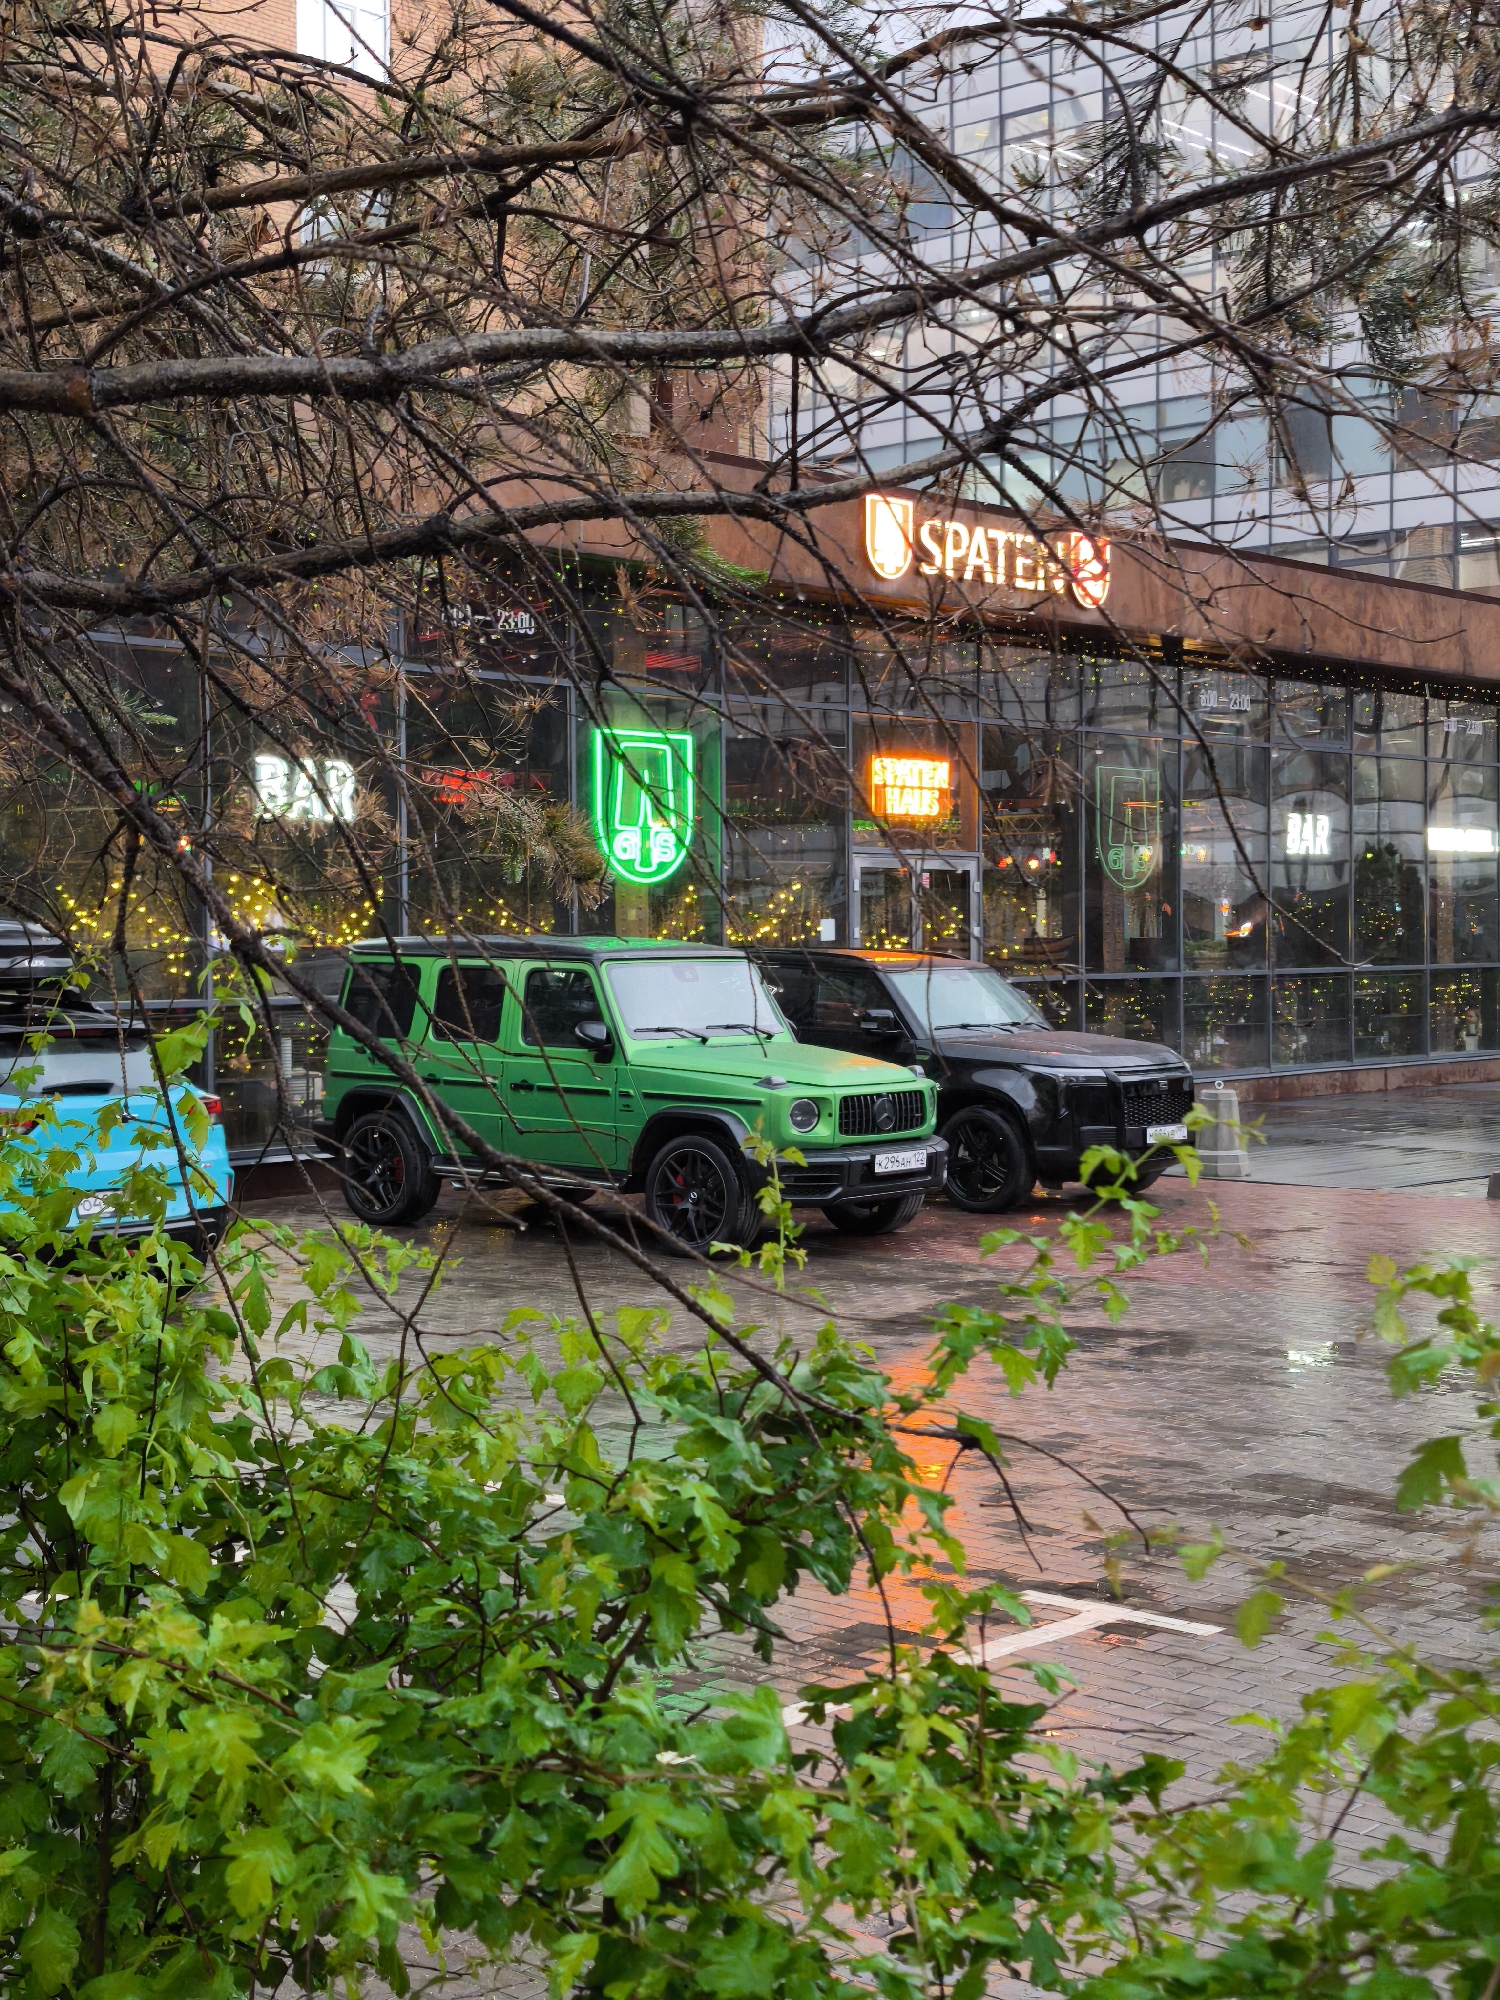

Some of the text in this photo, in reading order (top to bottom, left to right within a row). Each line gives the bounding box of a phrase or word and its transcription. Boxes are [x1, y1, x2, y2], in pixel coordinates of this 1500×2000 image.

[254, 755, 355, 821] BAR
[874, 757, 949, 788] SPATEN
[885, 786, 940, 816] HAUS
[1286, 812, 1330, 855] BAR
